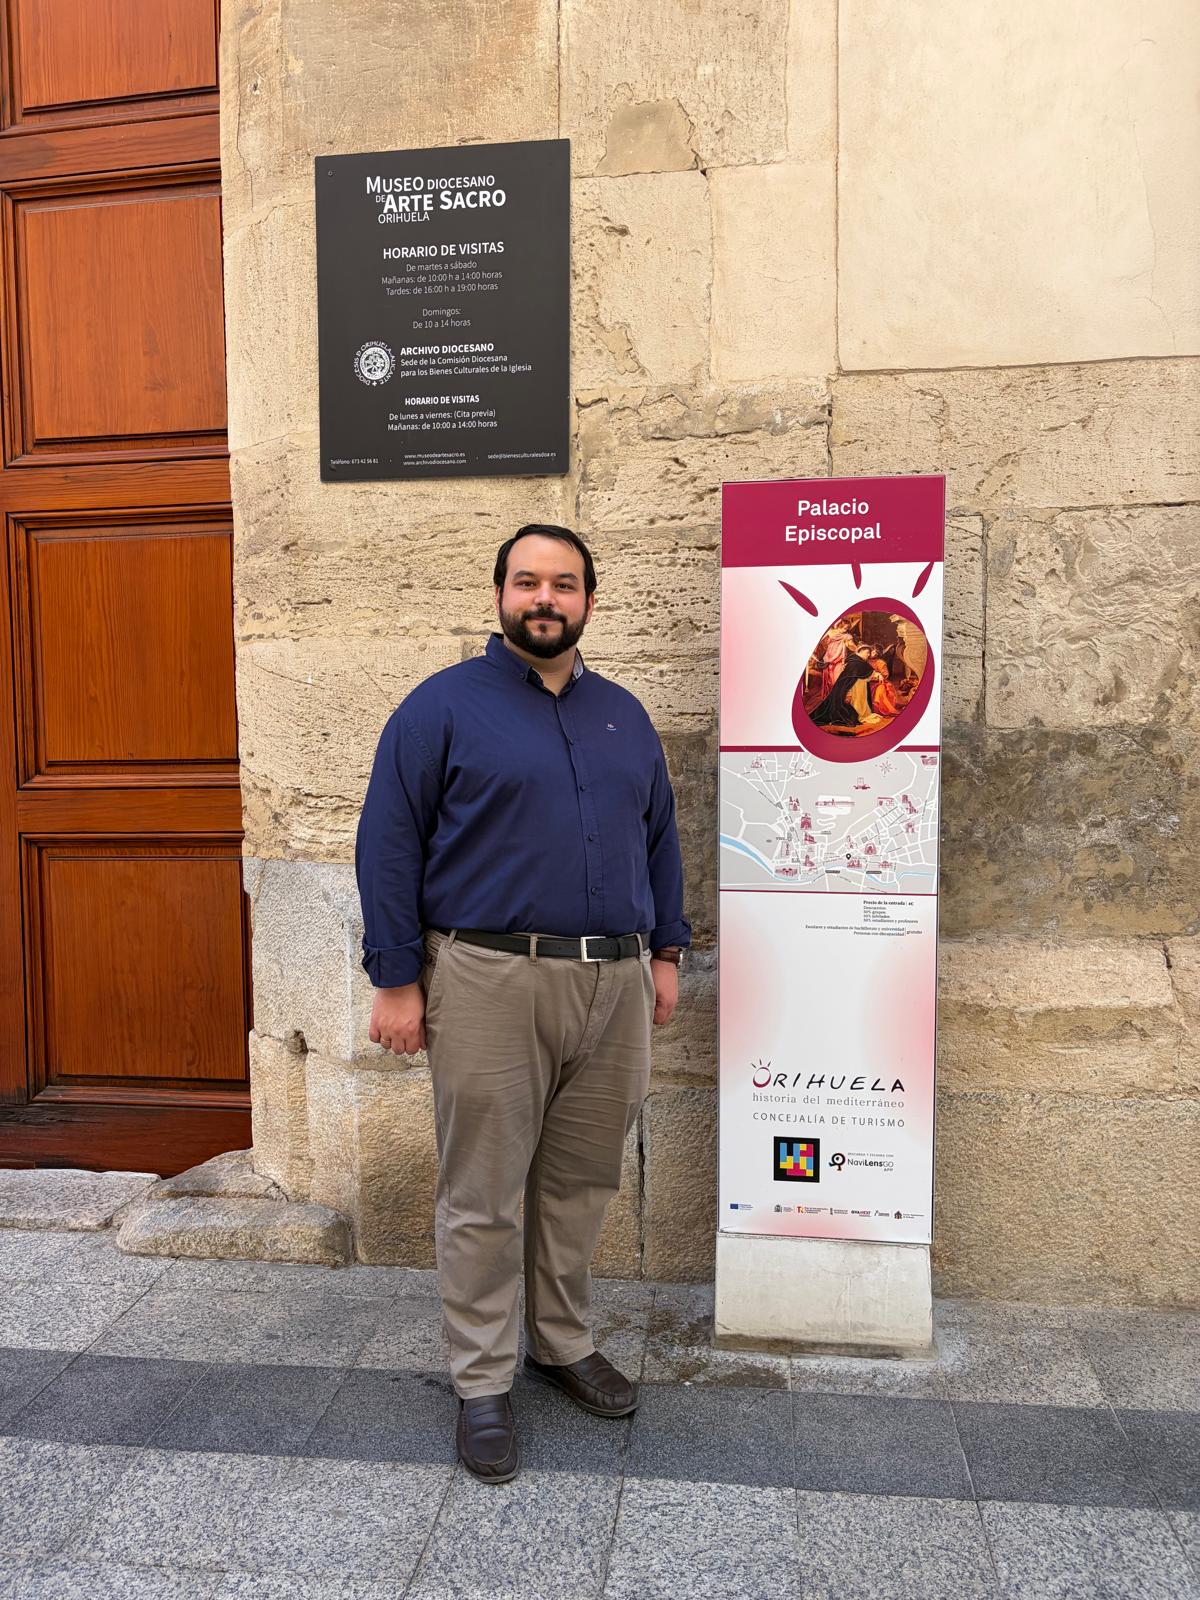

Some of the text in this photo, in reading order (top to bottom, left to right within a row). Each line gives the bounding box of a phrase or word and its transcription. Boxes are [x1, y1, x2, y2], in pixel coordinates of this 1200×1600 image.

[366, 175, 495, 194] MUSEO DIOCESANO
[376, 190, 506, 213] DE ARTE SACRO
[378, 212, 430, 224] ORIHUELA
[383, 241, 505, 260] HORARIO DE VISITAS
[406, 264, 416, 272] De
[418, 263, 442, 271] martes
[450, 261, 477, 270] sábado
[382, 276, 416, 285] Mañanas:
[417, 275, 427, 283] de
[428, 274, 447, 282] 10:00
[462, 272, 481, 280] 14:00
[386, 288, 412, 296] Tardes:
[413, 287, 423, 295] de
[424, 286, 443, 294] 16:00
[445, 285, 449, 293] h
[457, 284, 476, 292] 19:00
[478, 283, 499, 291] horas
[423, 308, 461, 317] Domingos:
[413, 321, 423, 329] De
[441, 320, 449, 328] 14
[451, 319, 471, 327] horas
[400, 343, 494, 356] ARCHIVO DIOCESANO
[401, 358, 418, 366] Sede
[420, 358, 428, 366] de
[438, 355, 470, 365] Comisión
[472, 355, 508, 363] Diocesana
[401, 370, 416, 379] para
[429, 367, 452, 376] Bienes
[454, 366, 489, 375] Culturales
[491, 365, 500, 373] de
[501, 364, 508, 372] la
[509, 364, 532, 373] Iglesia
[405, 395, 480, 406] HORARIO DE VISITAS
[389, 413, 399, 421] De
[454, 411, 470, 419] (Cita
[471, 409, 496, 418] previa)
[388, 423, 421, 431] Mañanas:
[478, 420, 498, 428] horas
[798, 499, 869, 517] Palacio
[786, 523, 881, 545] Episcopal
[753, 1067, 905, 1093] ORIHUELA
[753, 1093, 905, 1109] historia del mediterráneo
[753, 1112, 905, 1128] CONCEJALÍA DE TURISMO
